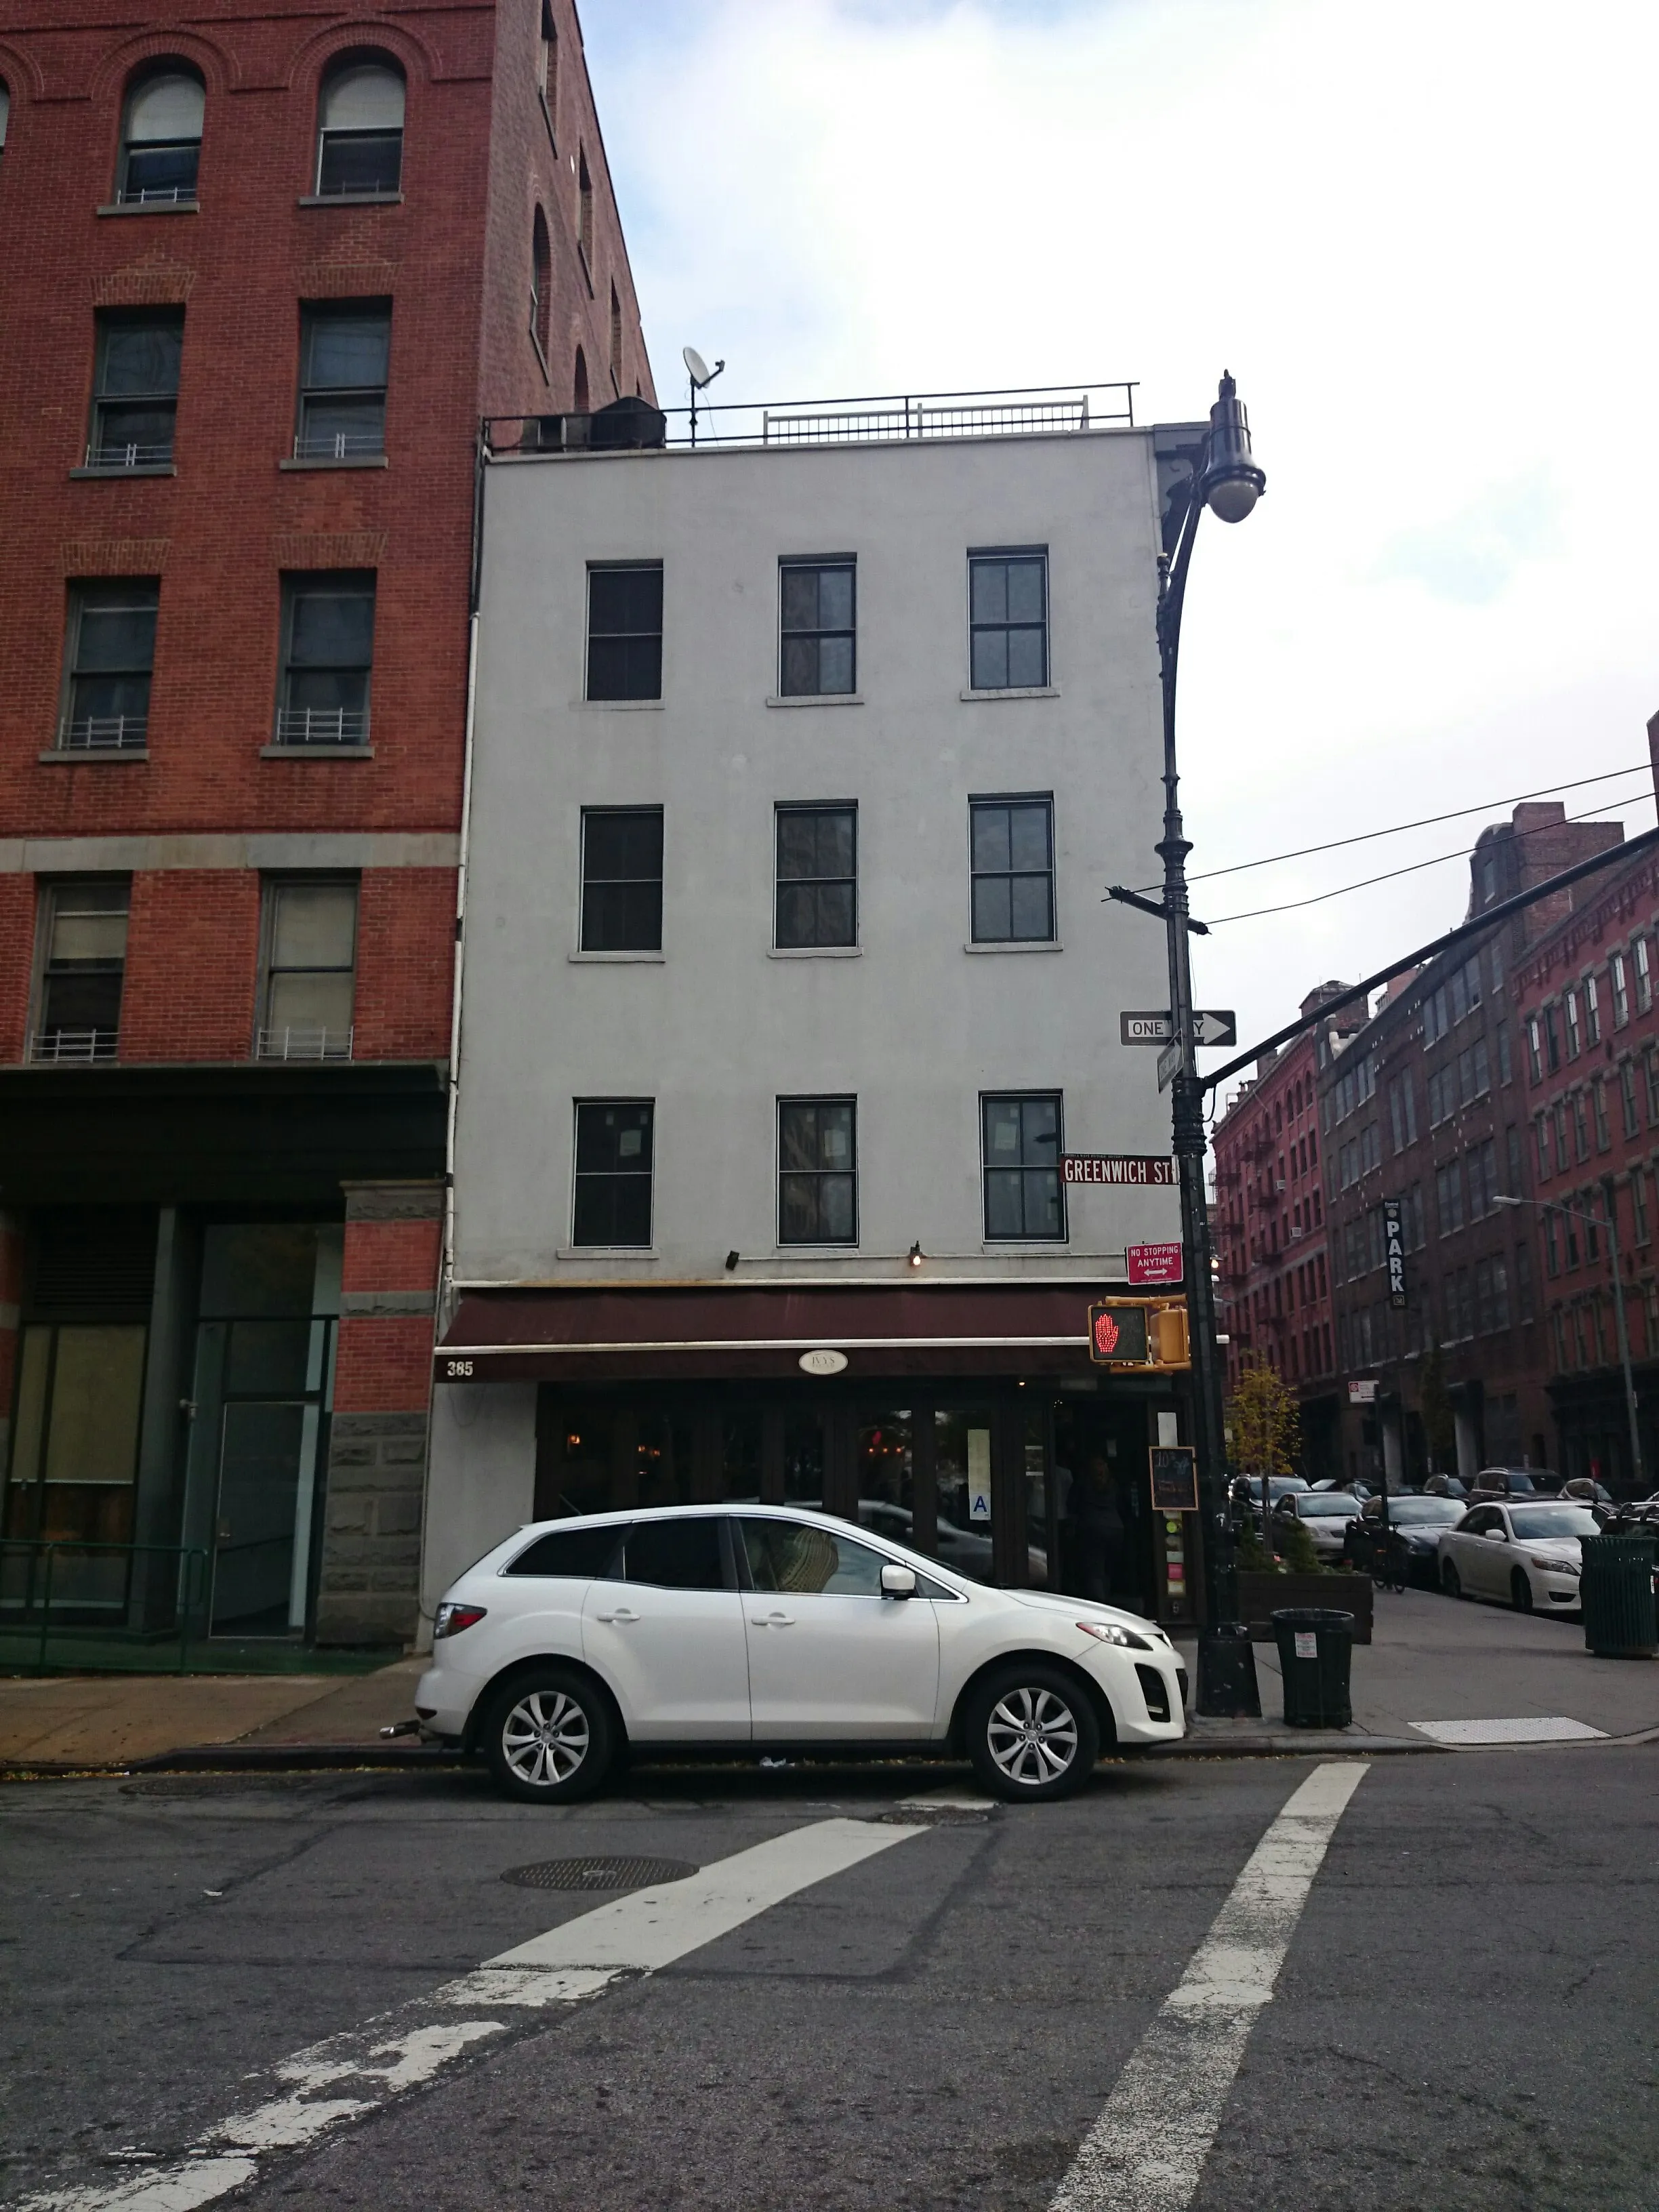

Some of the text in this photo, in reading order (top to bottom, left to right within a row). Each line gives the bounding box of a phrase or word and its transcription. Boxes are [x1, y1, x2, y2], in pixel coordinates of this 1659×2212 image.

[1132, 1022, 1164, 1035] ONE
[1065, 1159, 1170, 1183] GREENWICH ST
[1131, 1246, 1179, 1257] NO STOPPING
[1387, 1221, 1404, 1292] PARK
[1137, 1256, 1173, 1267] ANYTIME
[447, 1361, 473, 1376] 385
[973, 1496, 987, 1512] A
